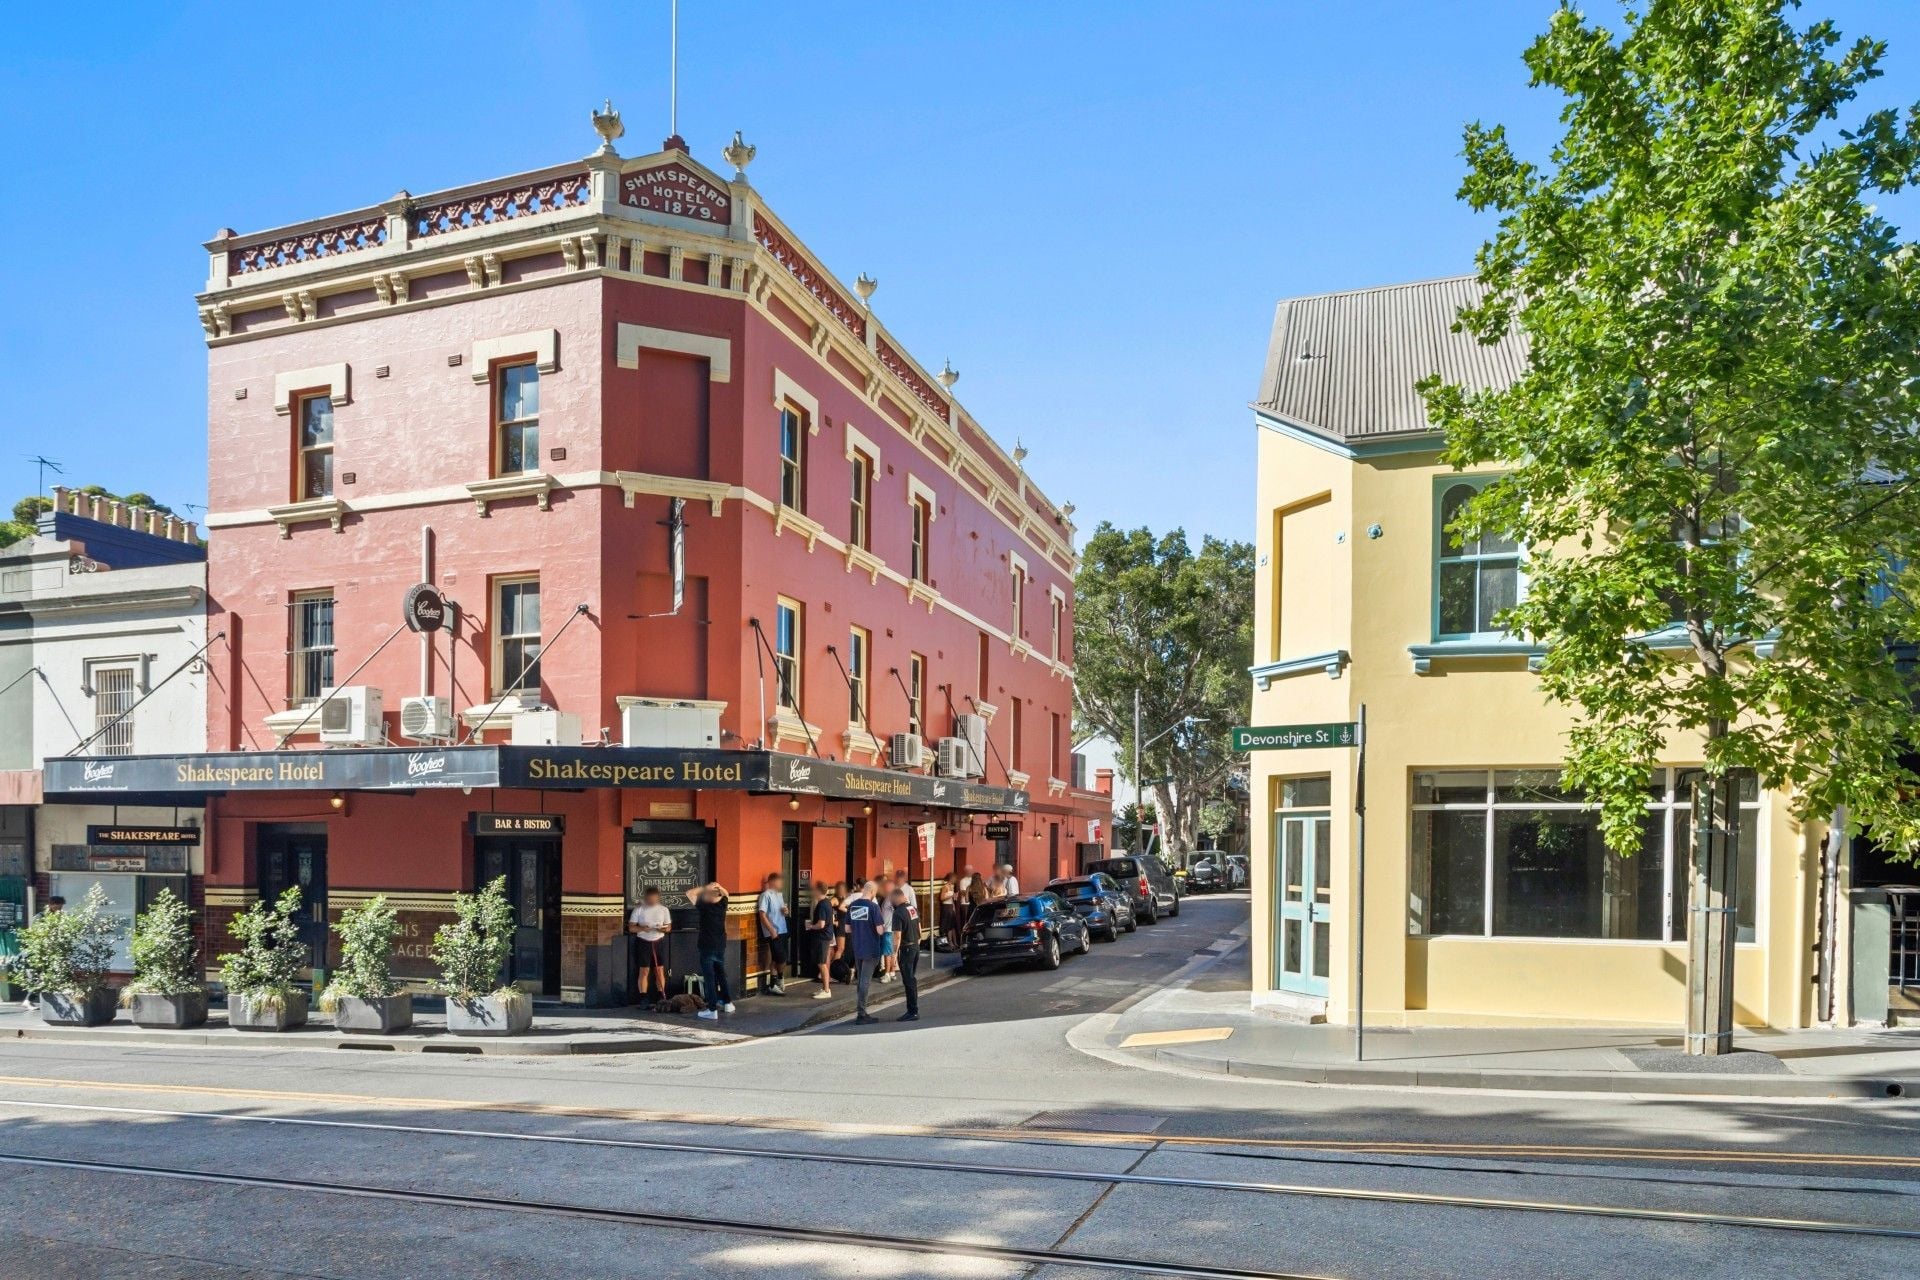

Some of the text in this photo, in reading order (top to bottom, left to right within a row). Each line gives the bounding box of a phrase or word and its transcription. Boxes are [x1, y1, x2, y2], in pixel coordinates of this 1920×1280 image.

[653, 186, 705, 205] HOTEL
[1240, 730, 1330, 746] Devonshire St
[83, 761, 115, 782] Coopers
[177, 761, 324, 786] Shakespeare Hotel
[408, 752, 446, 779] Coopers
[528, 758, 742, 785] Shakespeare Hotel
[845, 772, 892, 797] Shakespeare
[892, 779, 912, 796] Hotel
[494, 818, 552, 830] BAR & BISTRO
[110, 830, 181, 841] SHAKESPEARE
[392, 944, 434, 958] AGER
